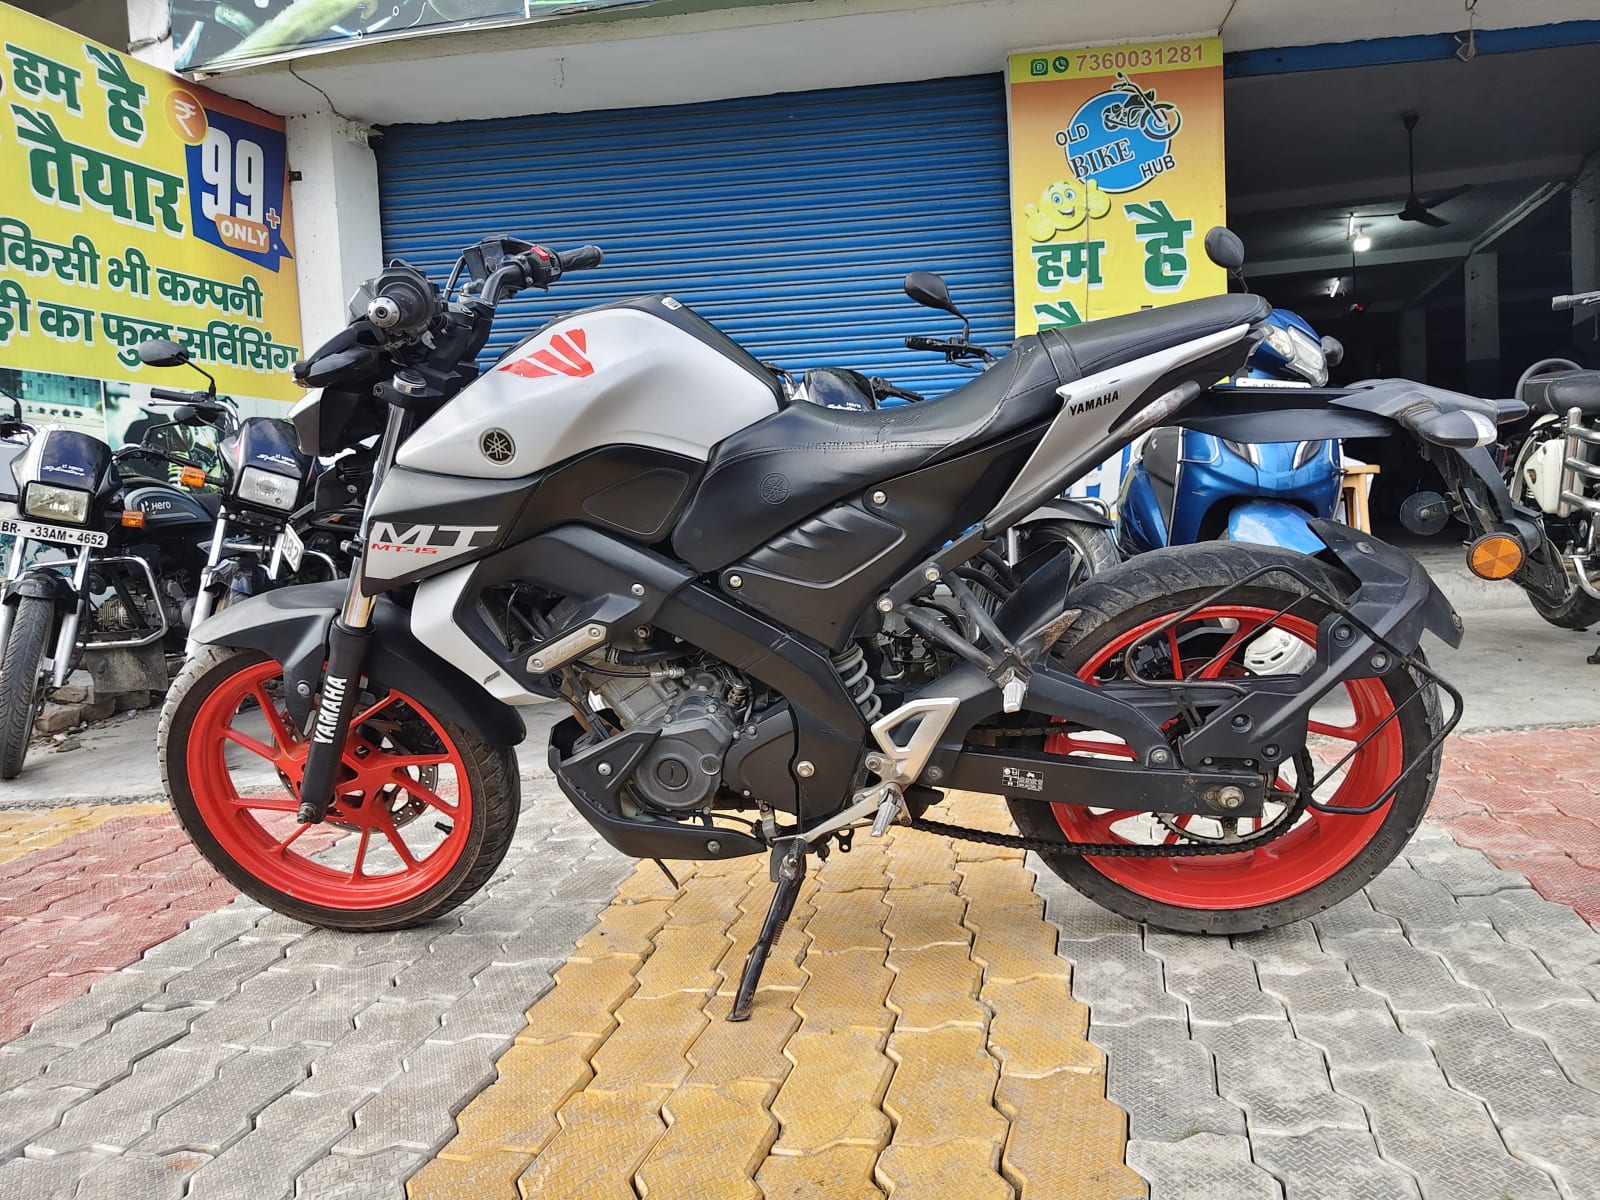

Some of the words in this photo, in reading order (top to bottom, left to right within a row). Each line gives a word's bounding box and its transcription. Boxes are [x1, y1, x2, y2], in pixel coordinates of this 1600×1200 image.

[1076, 44, 1204, 72] 7360031281
[5, 43, 82, 112] हम
[85, 43, 147, 143] है
[1055, 124, 1089, 147] OLD
[10, 103, 185, 233] तैयार
[202, 126, 265, 225] 99
[1069, 139, 1135, 179] BIKE
[1140, 155, 1176, 179] HUB
[220, 219, 269, 247] ONLY
[1031, 241, 1105, 287] हम
[1124, 200, 1193, 287] है
[0, 217, 100, 285] किसी
[107, 247, 151, 295] भी
[155, 267, 264, 320] कम्पनी
[38, 300, 95, 342] का
[1069, 390, 1120, 416] YAMAHA
[77, 532, 105, 546] 4652
[370, 521, 499, 548] MT
[371, 543, 438, 555] MT-15
[313, 675, 348, 744] YAMAHA
